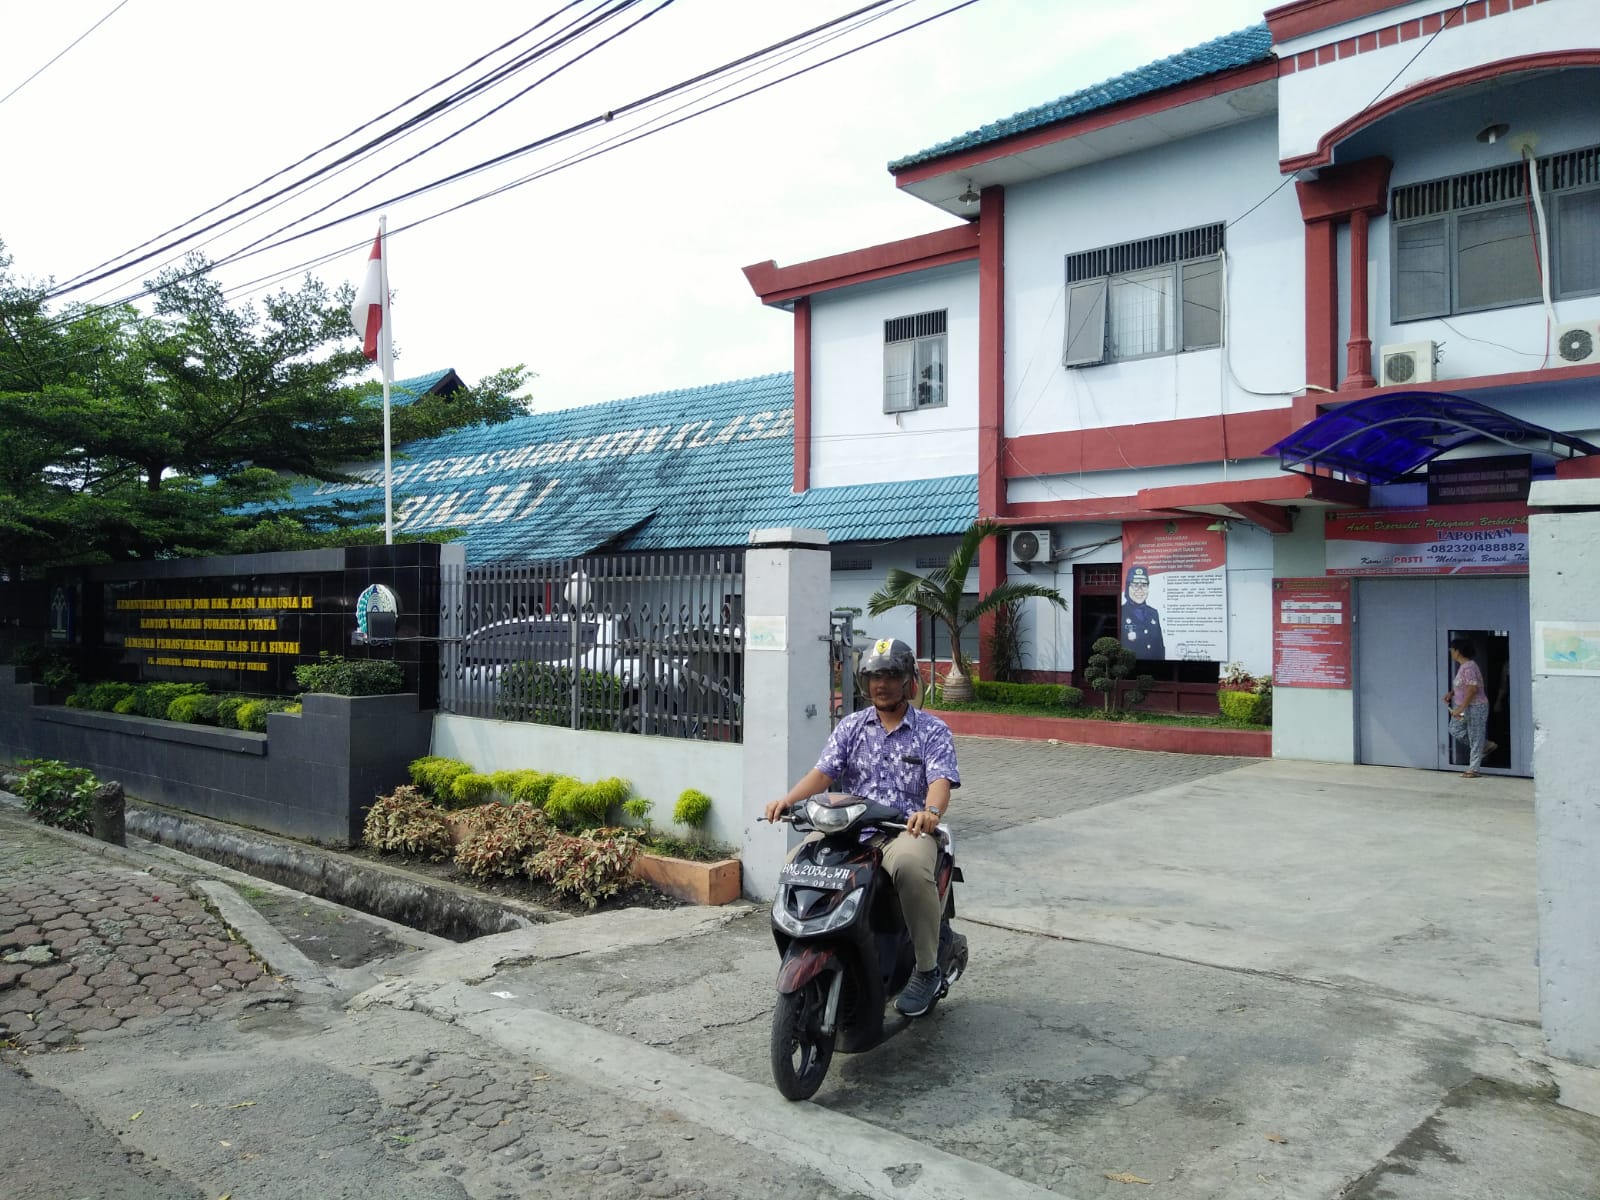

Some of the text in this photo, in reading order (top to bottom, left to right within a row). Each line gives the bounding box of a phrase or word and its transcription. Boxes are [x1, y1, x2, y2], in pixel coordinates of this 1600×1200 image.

[1426, 519, 1475, 529] Pelayanan
[1437, 527, 1513, 541] LAPORKAN
[1360, 557, 1382, 565] Kami
[211, 598, 229, 609] HAK
[231, 597, 256, 609] AZASI
[257, 597, 299, 609] MANUSIA
[301, 596, 313, 609] RI
[140, 618, 278, 631] KANTOR WILAYAH SUMATERA UTARA
[156, 638, 225, 651] PEMASYARAKATAN
[226, 640, 249, 652] KLAS
[269, 642, 300, 655] BINJAI
